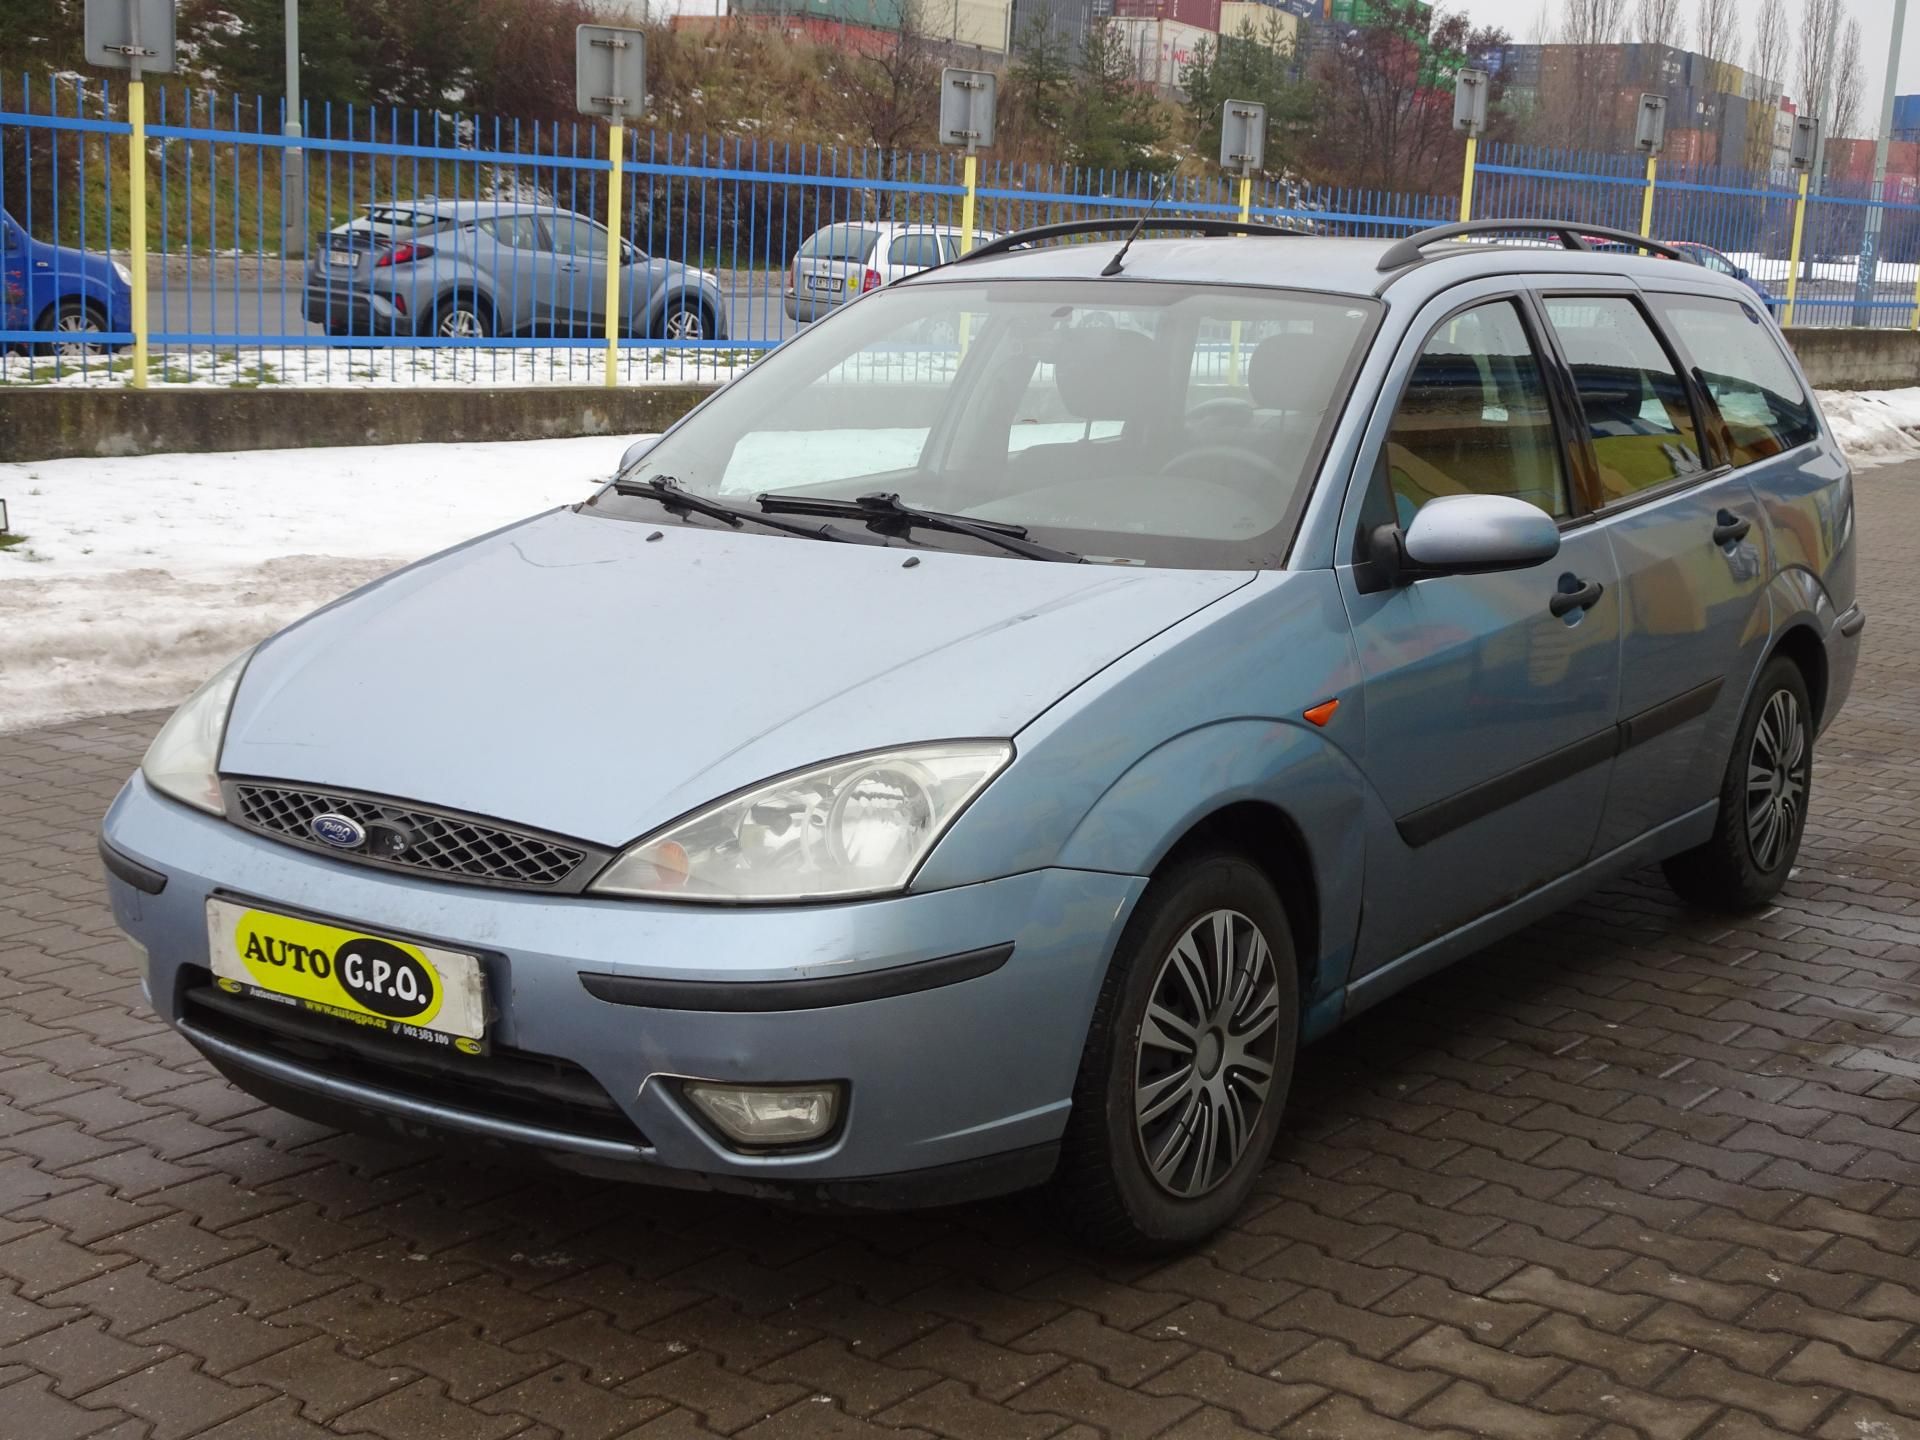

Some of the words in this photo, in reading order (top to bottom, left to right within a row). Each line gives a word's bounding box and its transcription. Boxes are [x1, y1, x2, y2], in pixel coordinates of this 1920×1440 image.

[321, 821, 351, 842] Ford
[244, 931, 331, 979] AUTO
[344, 953, 427, 1005] G.P.O.
[304, 1000, 387, 1029] www.autogpo.cz
